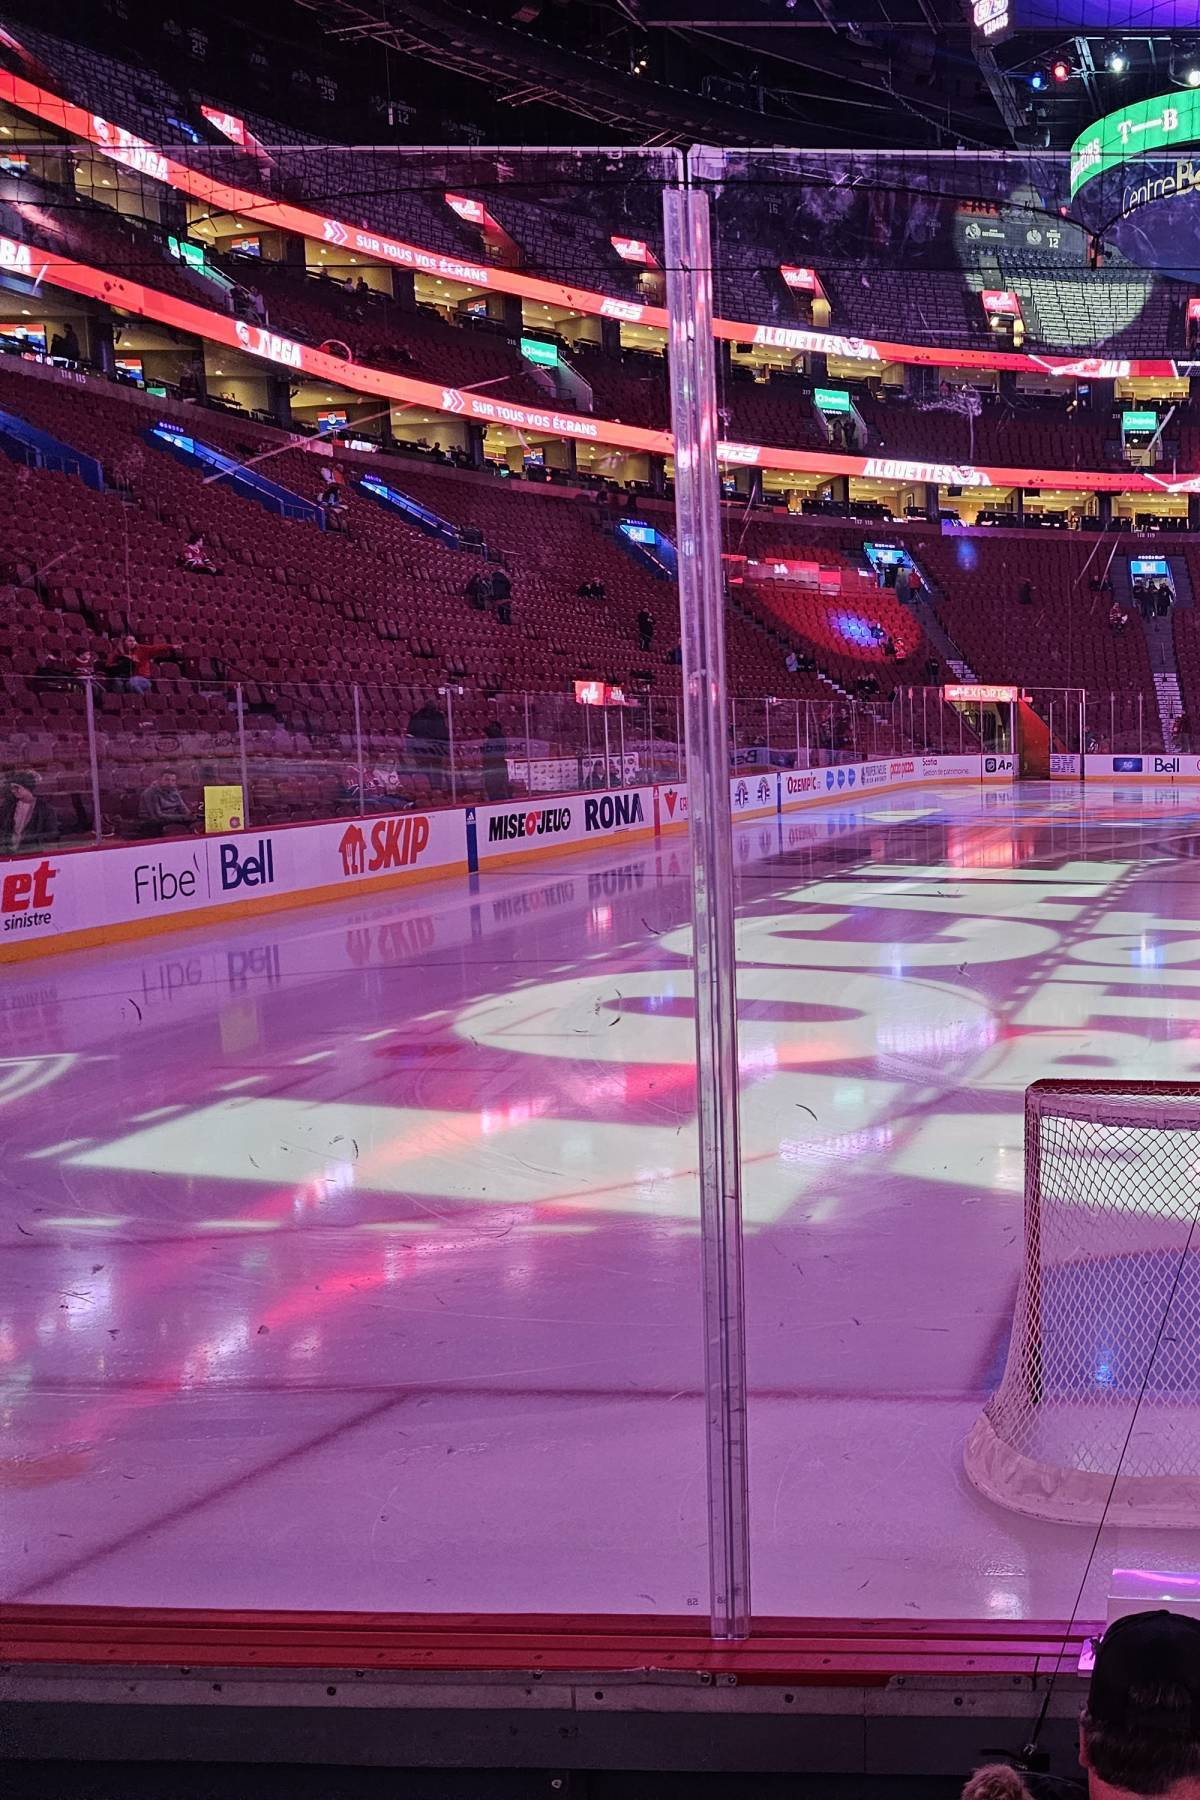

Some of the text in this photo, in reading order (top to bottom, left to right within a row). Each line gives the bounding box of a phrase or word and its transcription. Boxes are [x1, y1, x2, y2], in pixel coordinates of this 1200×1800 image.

[1049, 238, 1059, 248] 12
[356, 235, 488, 283] SUR TOUS VOS ÉCRANS
[754, 325, 842, 355] ALOUETTES
[472, 401, 597, 436] SUR TOUS VOS ÉCRANS
[863, 459, 951, 482] ALOUETTES
[922, 757, 938, 767] Scotia
[1155, 757, 1180, 772] Bell
[585, 793, 644, 831] RONA
[369, 816, 429, 871] SKIP
[220, 839, 274, 890] Bell
[4, 911, 51, 931] sinistre
